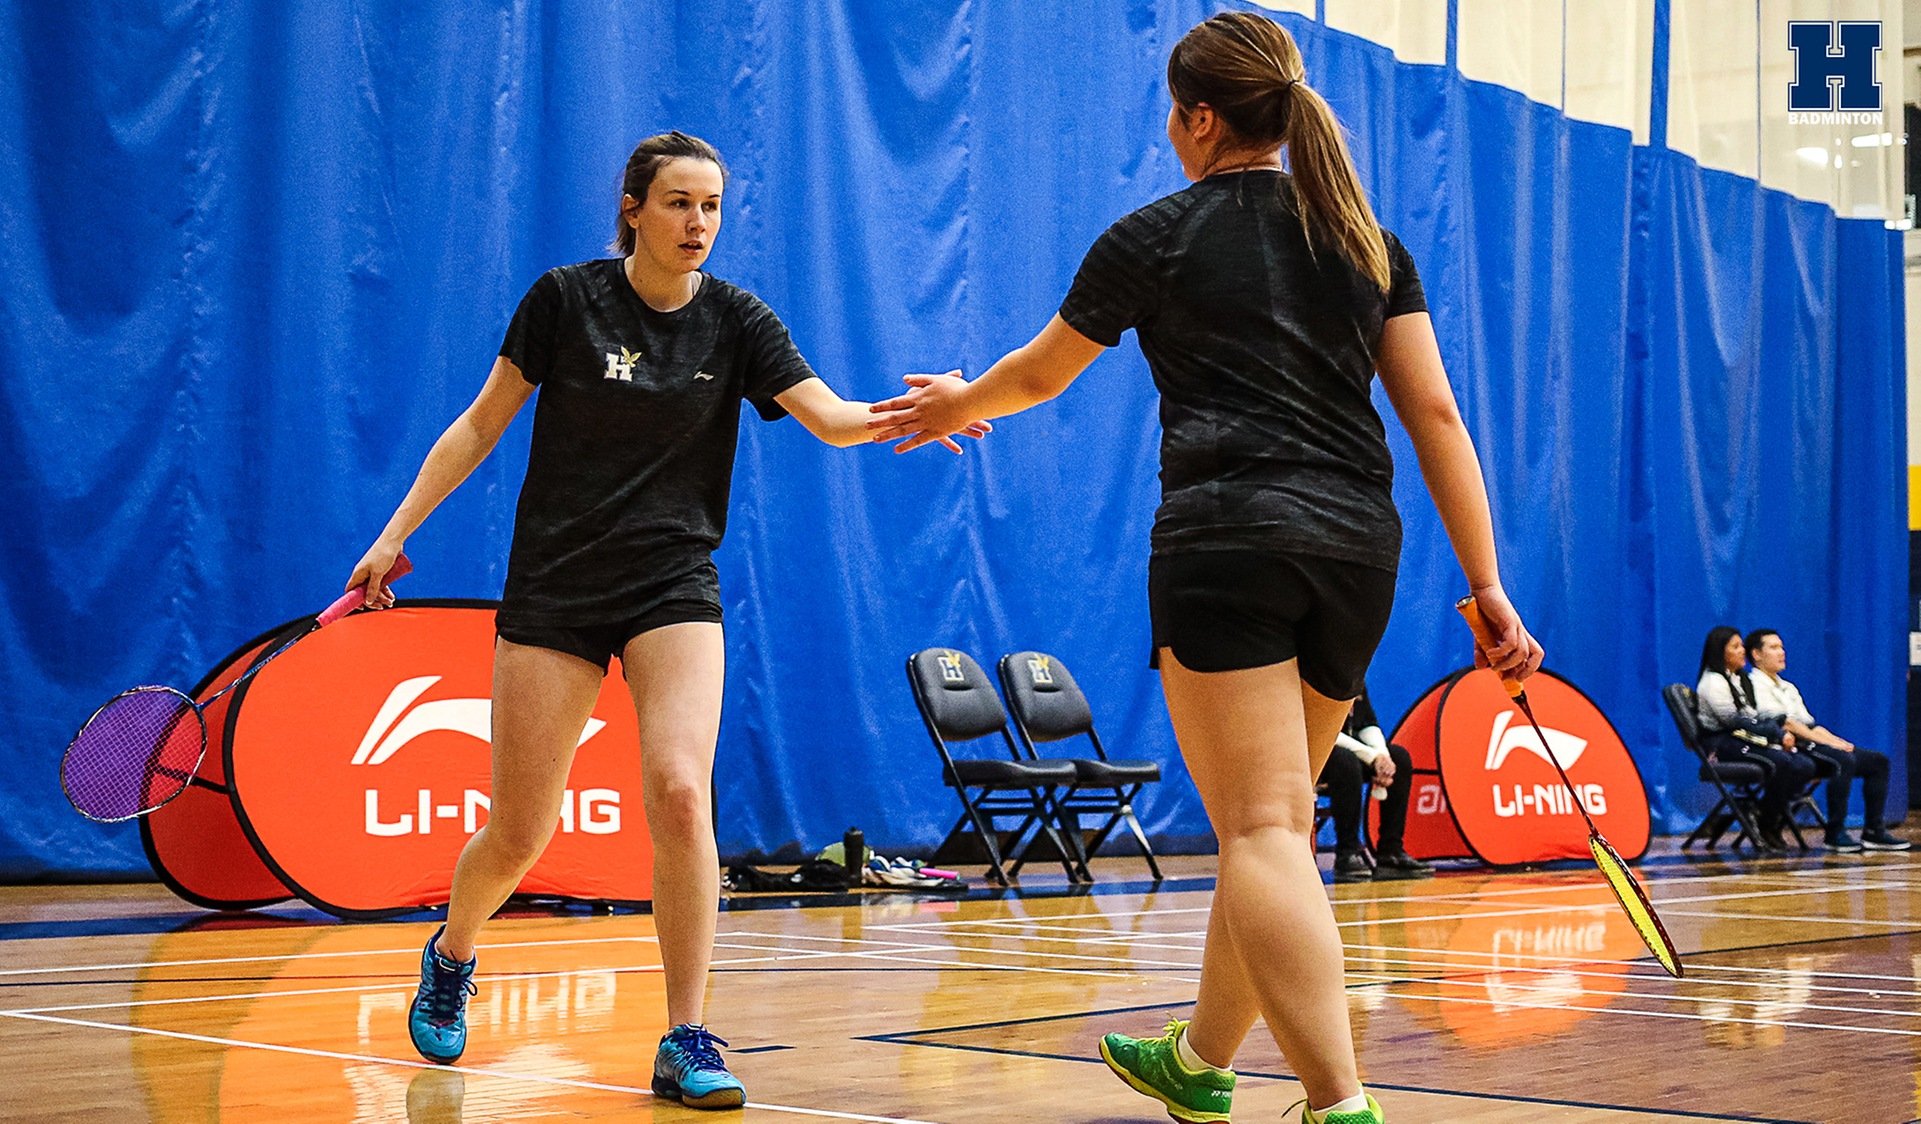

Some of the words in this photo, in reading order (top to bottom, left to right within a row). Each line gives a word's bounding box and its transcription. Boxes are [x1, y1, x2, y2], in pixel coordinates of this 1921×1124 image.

[604, 352, 633, 382] H
[365, 788, 621, 837] LI-NG
[1492, 784, 1608, 818] LI-NING
